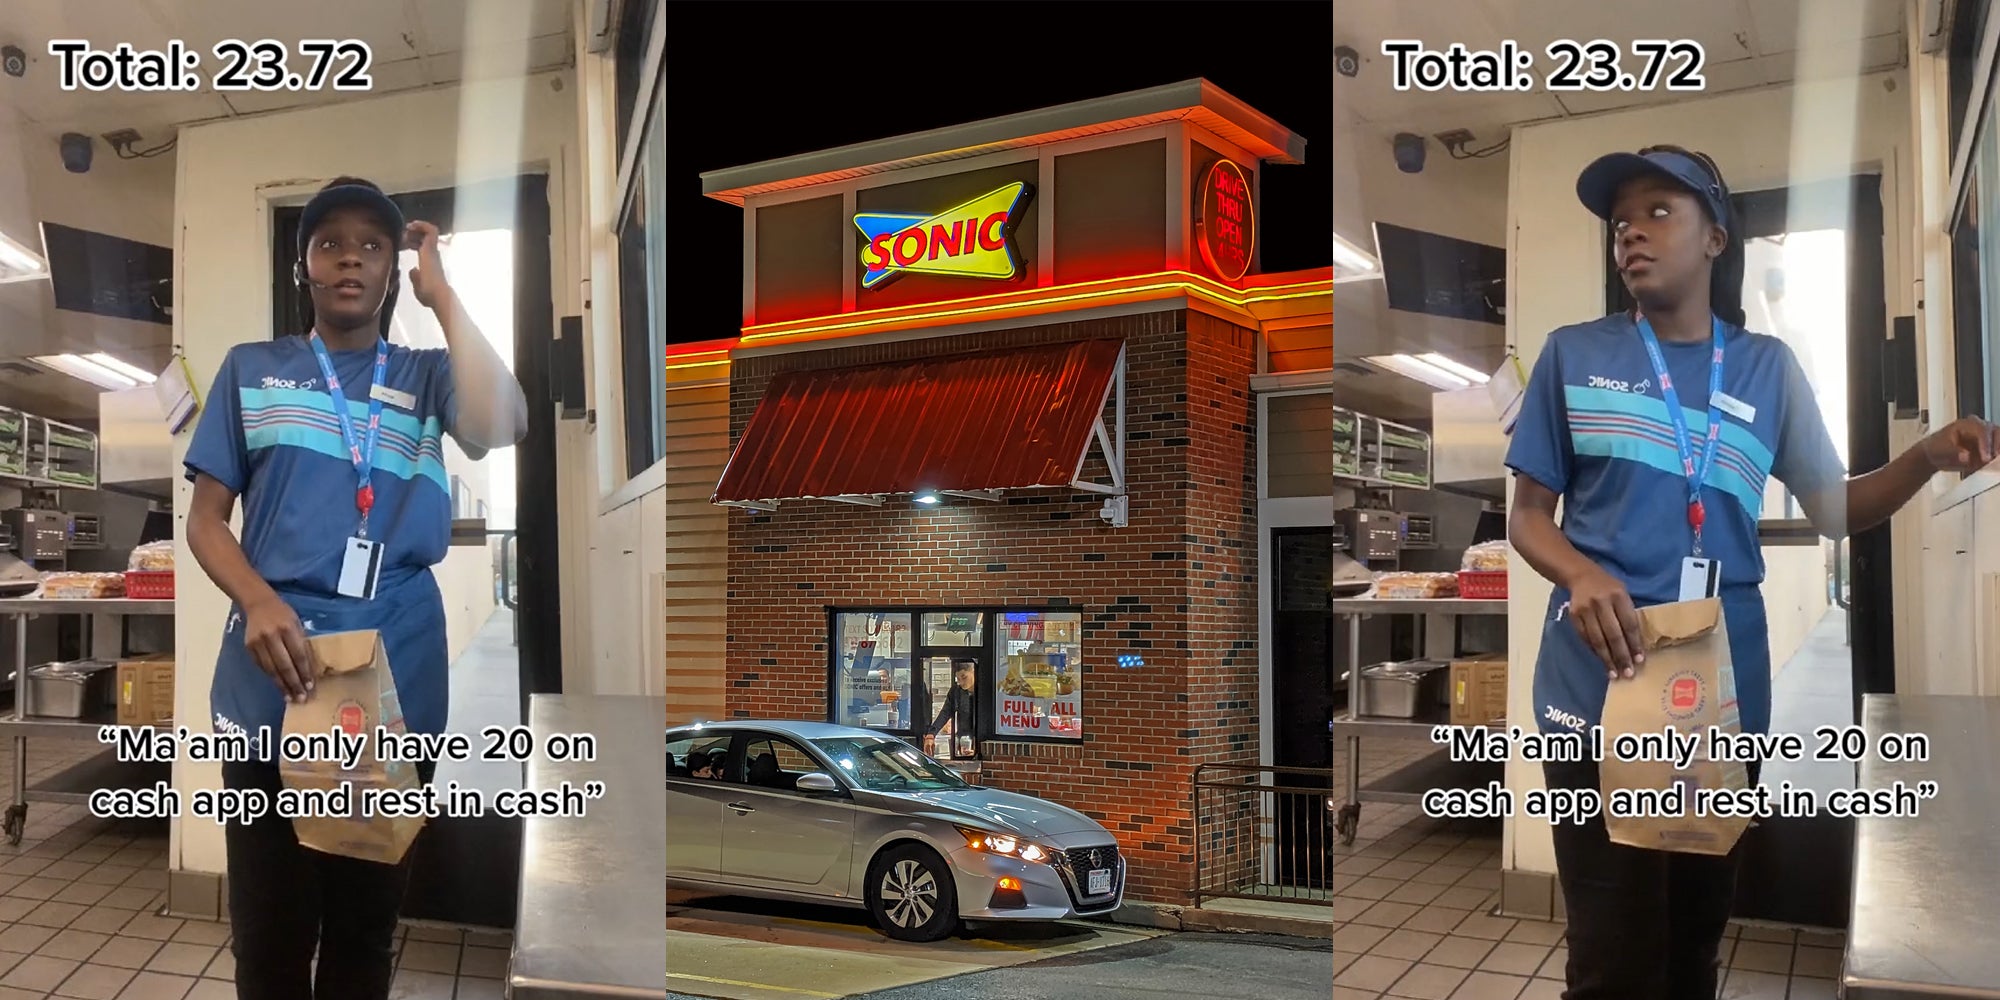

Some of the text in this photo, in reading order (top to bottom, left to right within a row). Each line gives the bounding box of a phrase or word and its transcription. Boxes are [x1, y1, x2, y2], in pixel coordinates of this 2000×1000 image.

[1214, 166, 1245, 201] DRIVE
[1215, 191, 1243, 223] THRU
[867, 211, 1009, 272] SONIC
[1215, 216, 1243, 246] OPEN
[1000, 714, 1041, 729] MENU
[1050, 701, 1077, 716] ALL
